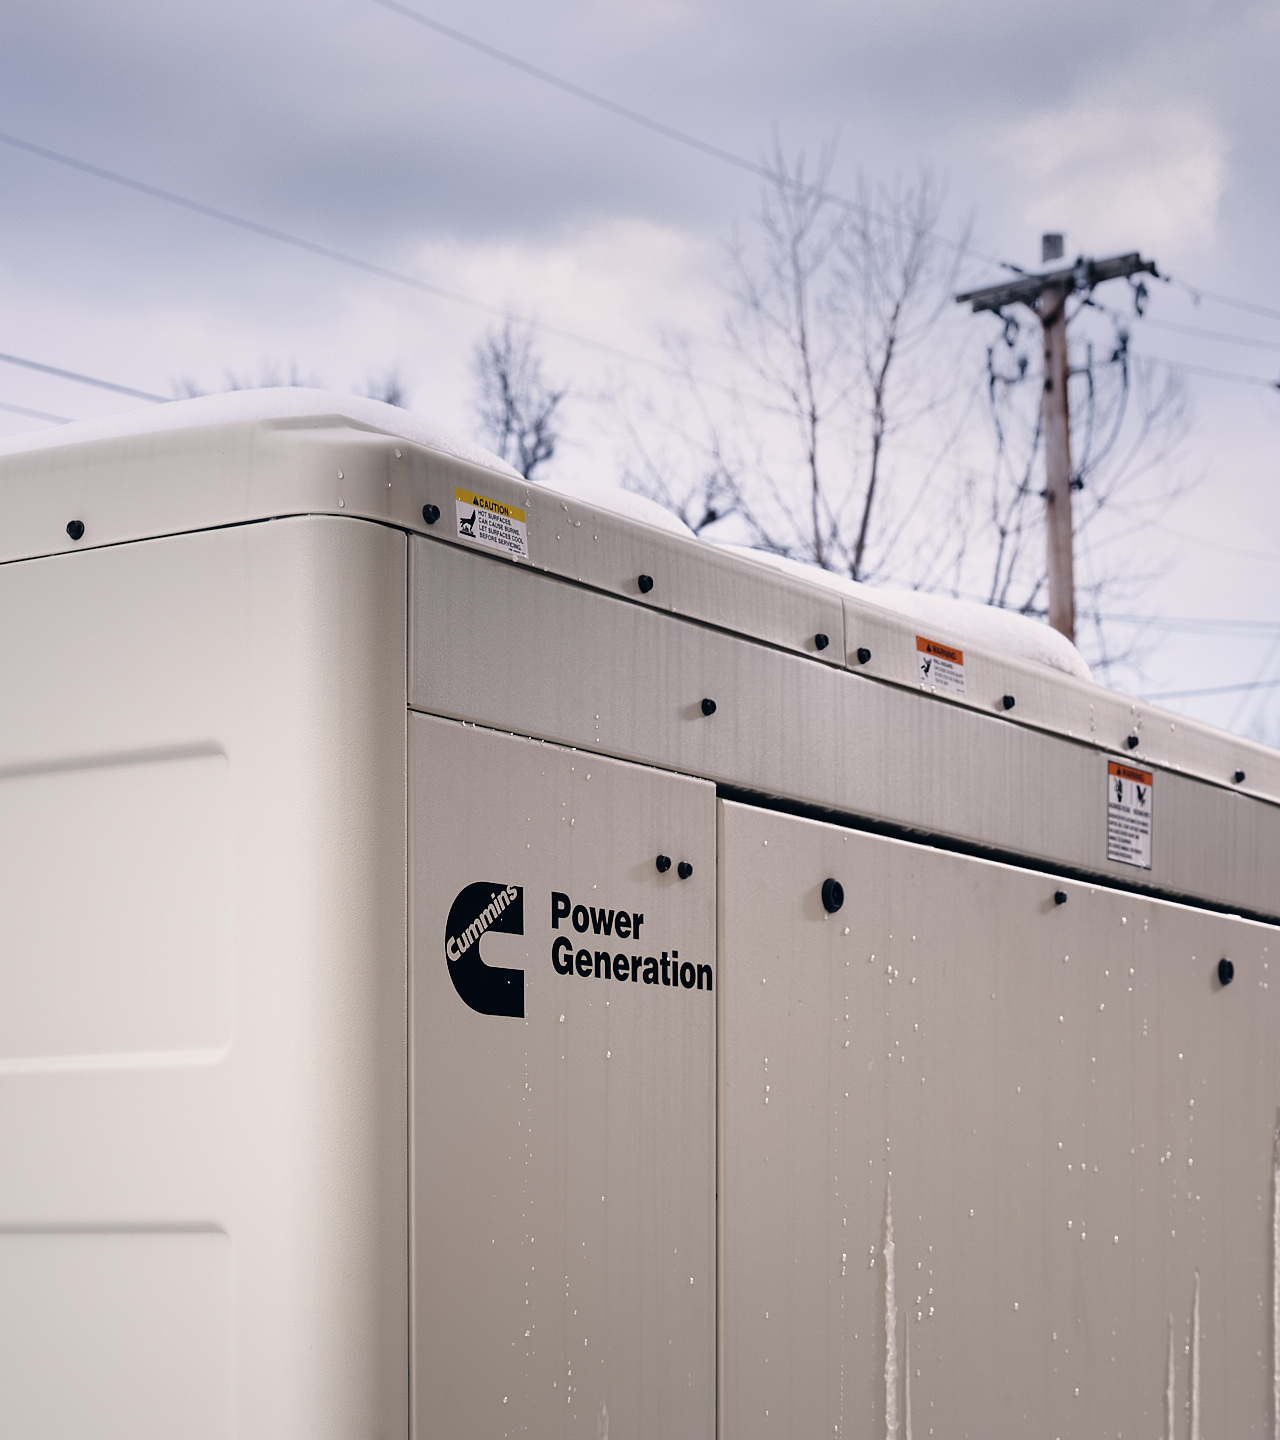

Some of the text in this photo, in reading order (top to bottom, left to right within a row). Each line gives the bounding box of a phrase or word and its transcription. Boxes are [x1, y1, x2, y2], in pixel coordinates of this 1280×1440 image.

[479, 499, 509, 516] CAUTION
[479, 524, 488, 532] LET
[488, 527, 511, 540] SURFACES
[489, 520, 504, 530] CAUSE
[479, 531, 497, 543] BEFORE
[446, 884, 518, 962] Cummins
[551, 891, 644, 940] Power
[551, 936, 713, 991] Generation
